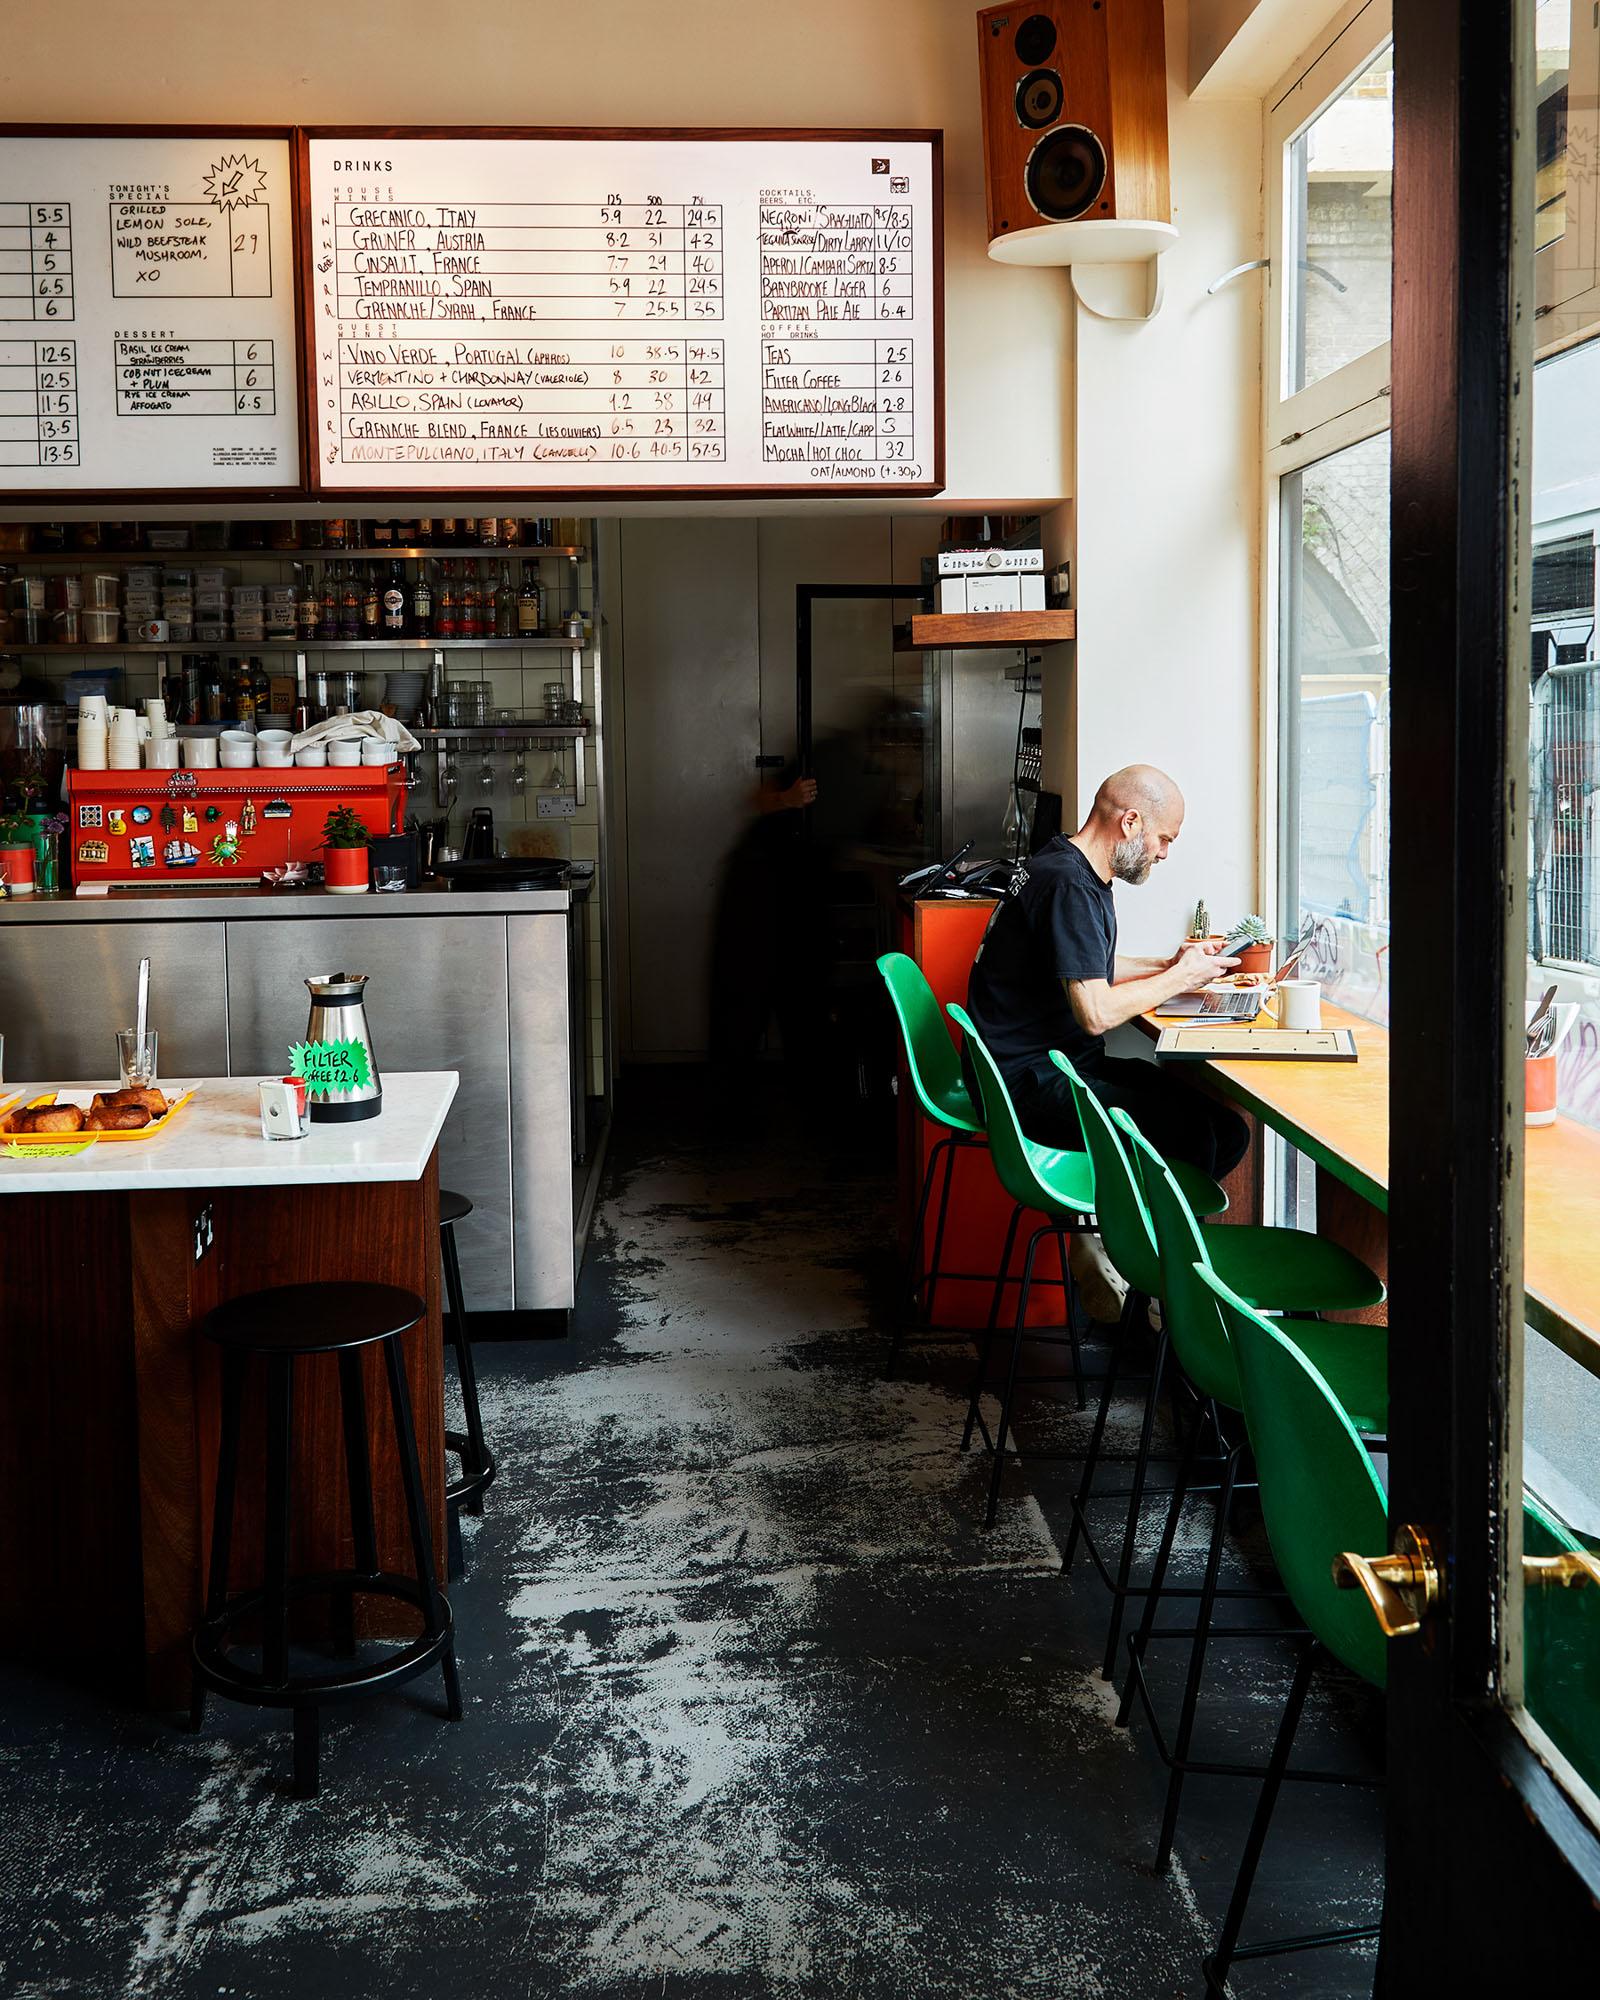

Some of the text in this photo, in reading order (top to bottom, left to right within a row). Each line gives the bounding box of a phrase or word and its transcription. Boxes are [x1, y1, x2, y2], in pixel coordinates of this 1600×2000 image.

[334, 161, 393, 171] DRINKS
[607, 194, 622, 206] 125
[37, 208, 63, 223] 5.5
[120, 206, 166, 215] GRILLED
[350, 207, 431, 229] GRECANICO,
[436, 208, 476, 228] ITALY
[601, 208, 621, 224] 5.9
[645, 209, 667, 225] 22
[688, 209, 716, 227] 29.5
[116, 218, 212, 231] LEMON SOLE,
[45, 232, 57, 249] 4
[117, 236, 207, 248] WILD BEEFSTEAK
[233, 234, 258, 255] 29
[437, 230, 485, 250] AUSTRIA
[606, 232, 629, 248] 8.2
[649, 232, 662, 248] 31
[690, 233, 714, 249] 43
[845, 230, 873, 252] LARRY
[44, 254, 55, 271] 5
[136, 249, 208, 262] MUSHROOM,
[433, 251, 481, 274] FRANCE
[608, 255, 628, 272] 7.7
[649, 255, 666, 270] 29
[692, 255, 714, 273] 40
[879, 257, 897, 275] 8.5
[136, 269, 160, 283] XO
[39, 279, 64, 294] 6.5
[354, 275, 449, 297] TEMPRANILLO,
[452, 275, 492, 297] SPAIN
[609, 278, 630, 297] 5.9
[648, 279, 666, 295] 22
[689, 278, 718, 294] 29.5
[834, 277, 866, 298] LAGER
[883, 279, 890, 296] 6
[46, 300, 57, 315] 6
[493, 300, 536, 321] FRANCE
[615, 302, 626, 317] 7
[646, 301, 679, 317] 25.5
[694, 301, 715, 317] 35
[764, 300, 906, 321] PARTIZAN PALE ALE 6.4
[338, 323, 397, 331] GUEST
[42, 347, 71, 363] 12.5
[120, 343, 258, 361] BASIL ICE CREAM 6
[322, 349, 332, 360] W
[347, 343, 386, 364] VINO
[454, 342, 523, 364] PORTUGAL
[611, 344, 624, 358] 10
[646, 345, 679, 360] 38.5
[689, 345, 720, 361] 54.5
[765, 345, 907, 364] TEAS 2.5
[41, 372, 70, 389] 12.5
[143, 379, 169, 390] PLUM
[246, 369, 257, 387] 6
[323, 374, 333, 387] W
[347, 370, 434, 385] VERMENTINO
[452, 371, 533, 386] CHARDONNAY
[613, 370, 622, 384] 8
[648, 370, 668, 384] 30
[690, 369, 712, 384] 42
[765, 369, 902, 389] FILTER COFFEE 2.6
[42, 395, 69, 414] 11.5
[130, 401, 172, 411] AFFOGATO
[238, 394, 261, 409] 6.5
[419, 393, 462, 411] SPAIN
[654, 392, 673, 411] 38
[692, 392, 712, 411] 49
[883, 397, 905, 412] 2.8
[42, 420, 70, 438] 13.5
[327, 420, 336, 434] R
[348, 417, 420, 438] GRENACHE
[480, 421, 528, 438] FRANCE
[611, 417, 634, 435] 6.5
[655, 418, 673, 435] 23
[695, 418, 716, 434] 32
[882, 417, 896, 433] 3
[44, 445, 73, 463] 13.5
[351, 445, 479, 463] MONTEPULCIANO,
[483, 446, 524, 461] ITALY
[611, 442, 641, 459] 10.6
[650, 441, 682, 458] 40.5
[692, 442, 721, 458] 57.5
[835, 447, 863, 461] CHOC
[886, 441, 904, 458] 3.2
[304, 1050, 353, 1068] FILTER
